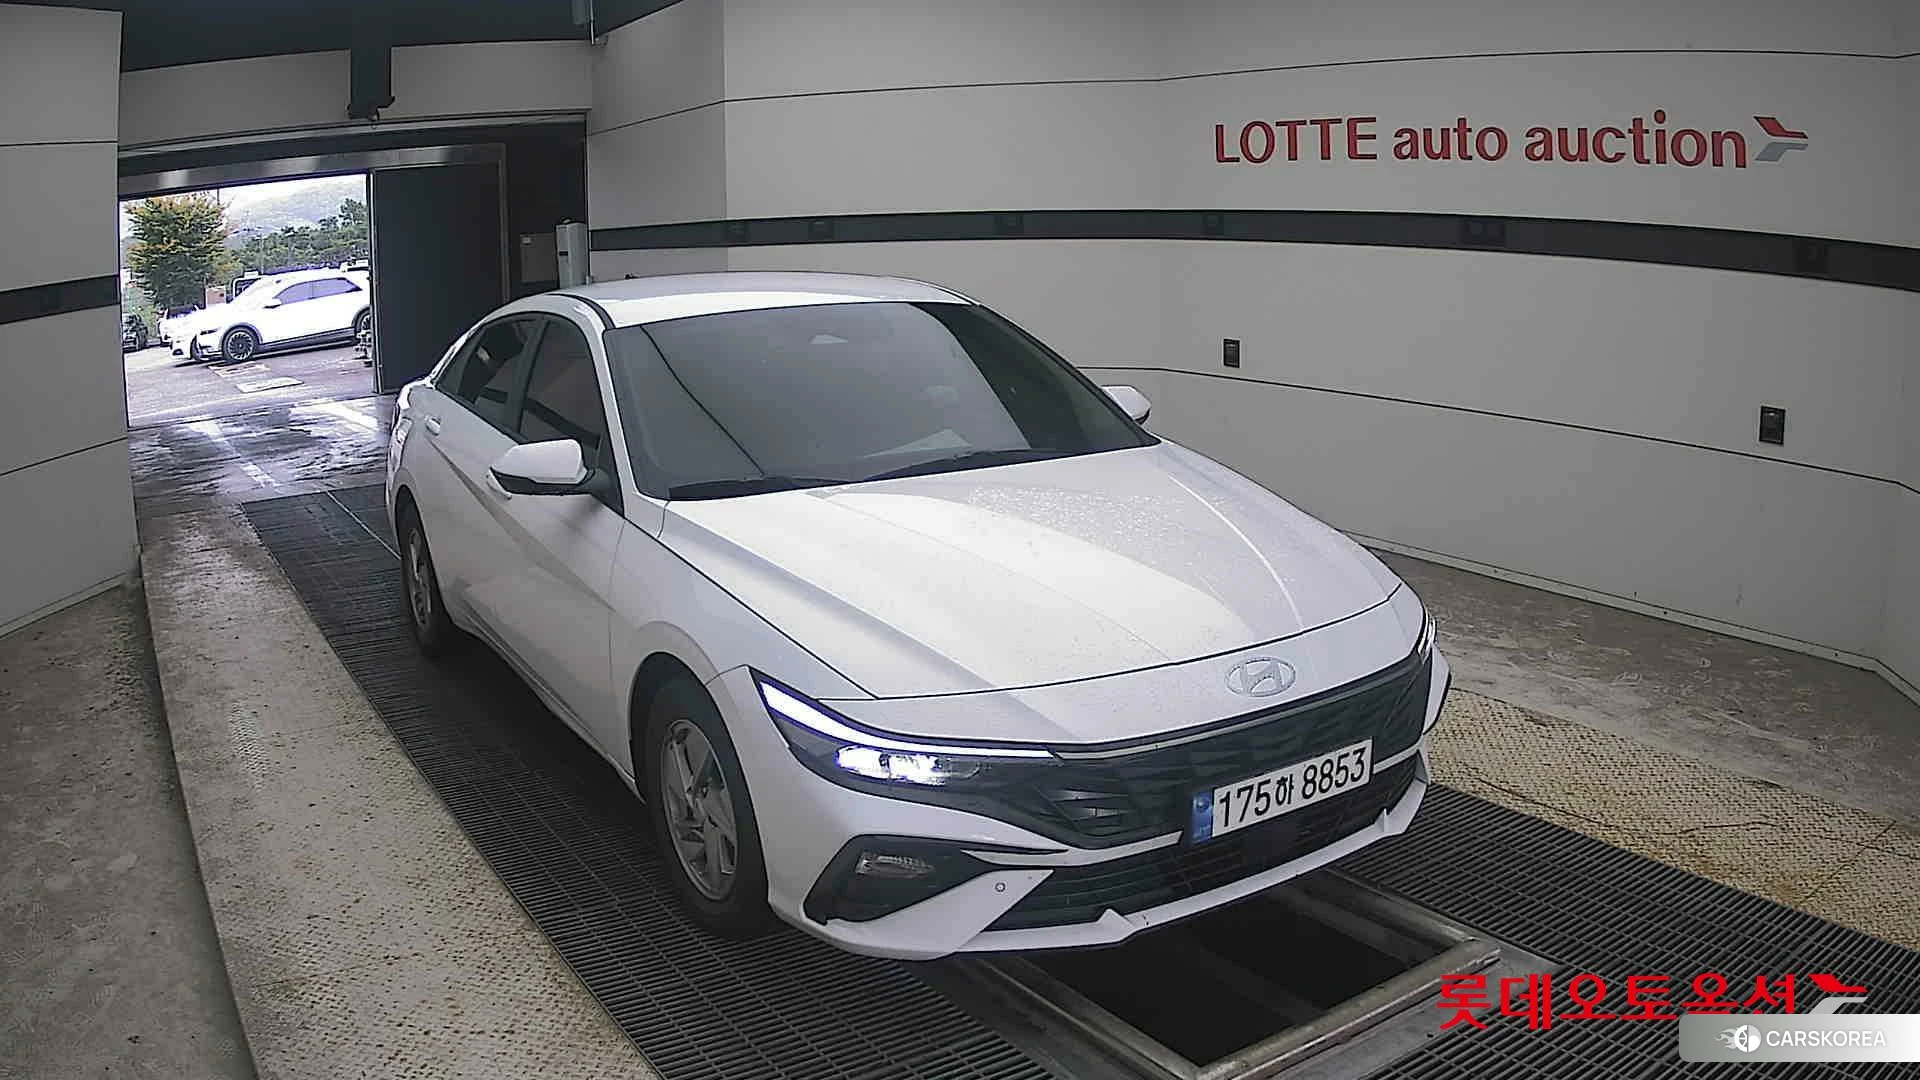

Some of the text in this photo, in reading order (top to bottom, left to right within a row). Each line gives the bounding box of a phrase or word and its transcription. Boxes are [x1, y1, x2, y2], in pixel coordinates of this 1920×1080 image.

[1215, 109, 1747, 168] LOTTE auto auction
[1219, 747, 1367, 828] 175하 8853
